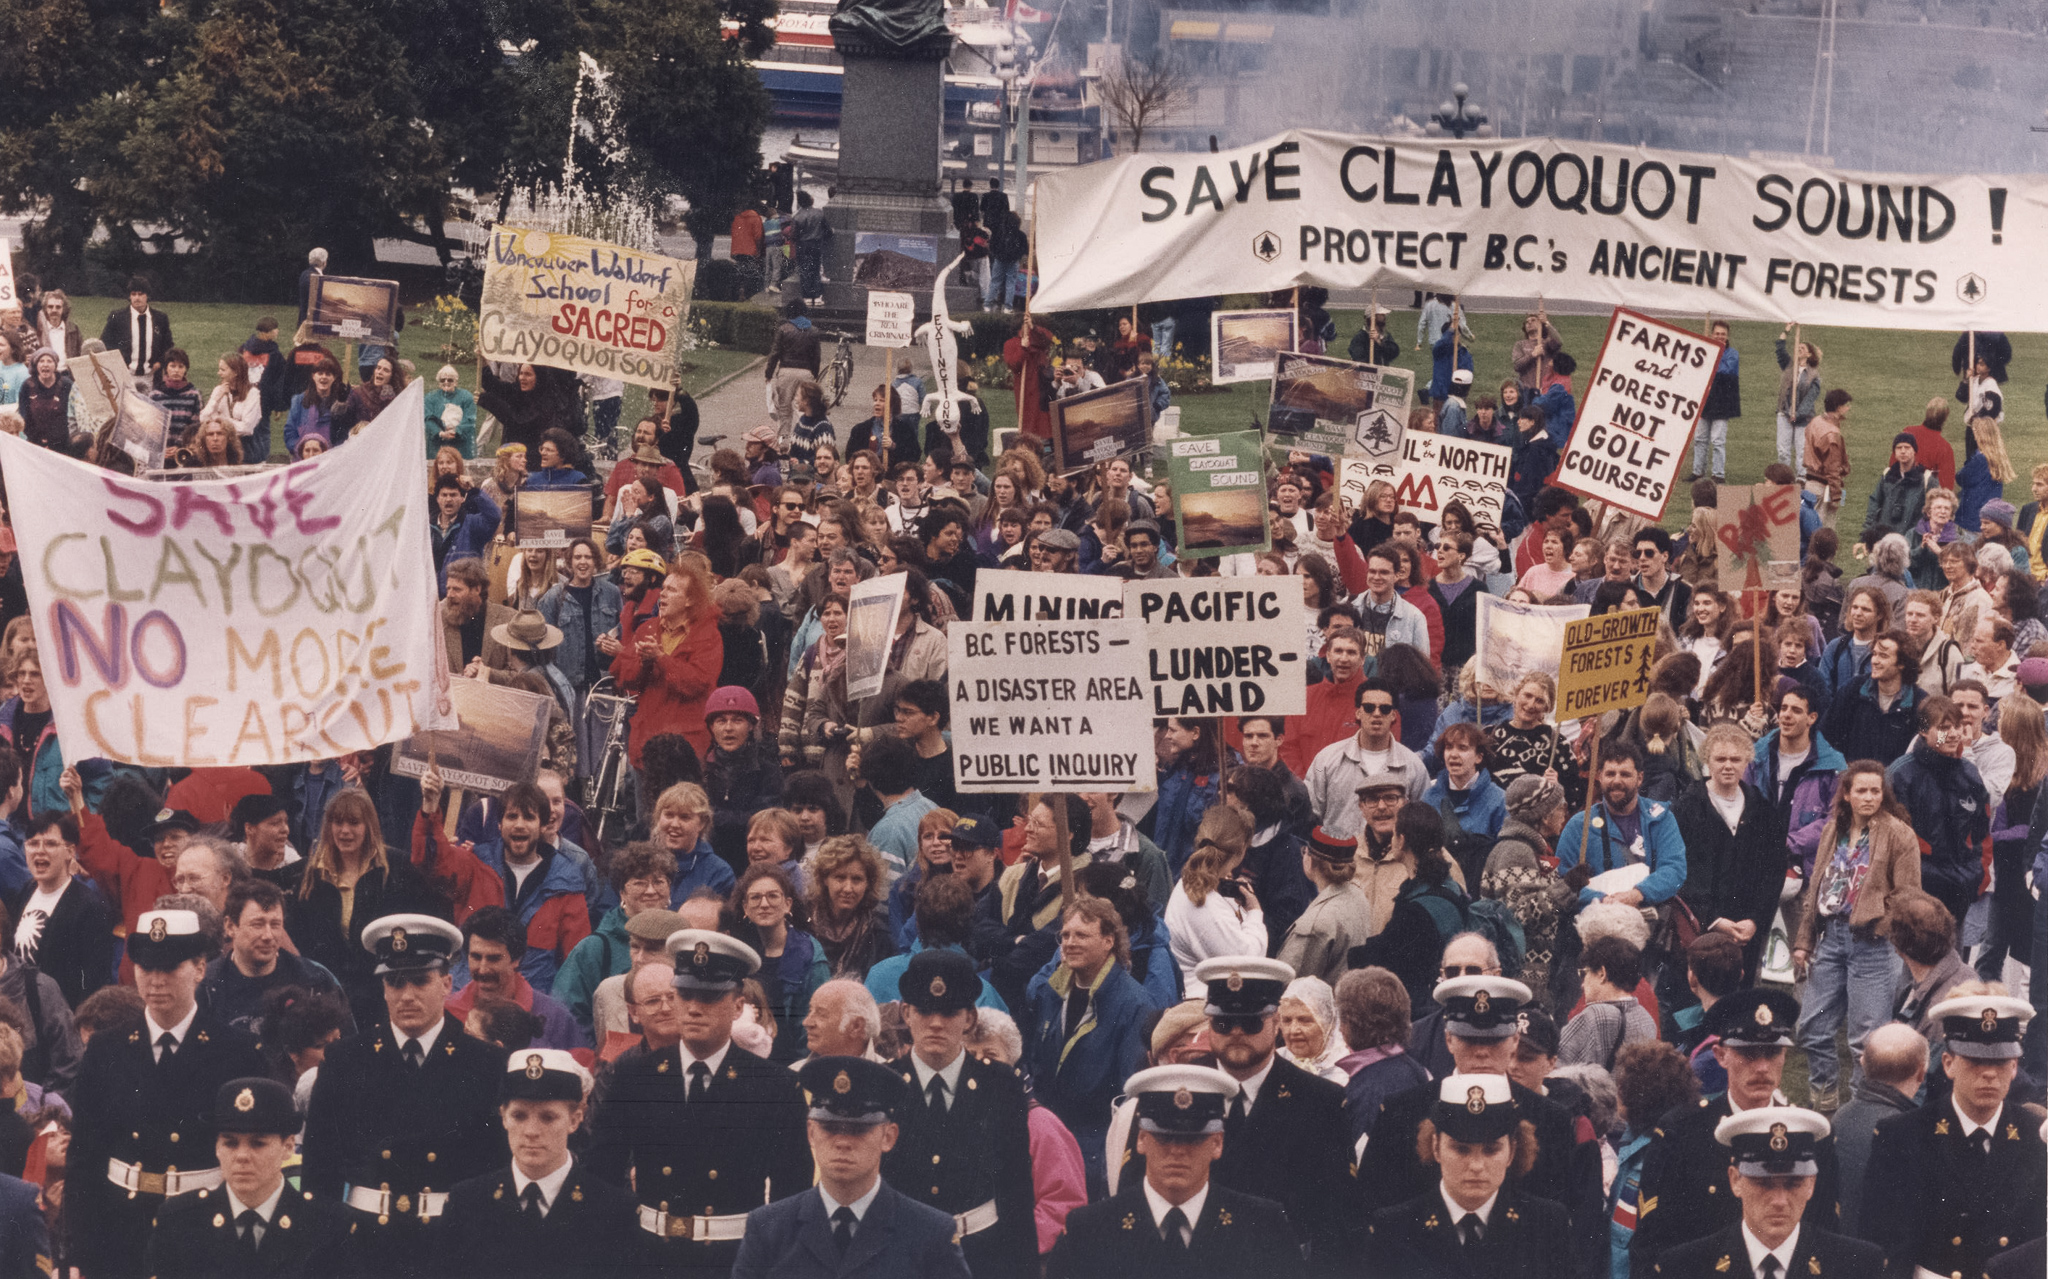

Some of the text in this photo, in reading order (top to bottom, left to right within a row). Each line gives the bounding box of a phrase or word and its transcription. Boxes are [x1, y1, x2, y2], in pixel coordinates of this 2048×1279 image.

[779, 19, 814, 30] ROYAL
[1141, 142, 2007, 245] SAVE CLAYOQUOT SOUND !
[591, 249, 672, 293] Waldorf
[1301, 225, 1467, 270] PROTECT
[1589, 239, 1746, 289] ANCIENT
[1765, 258, 1938, 303] FORESTS
[527, 274, 611, 305] School
[626, 290, 675, 317] for a
[872, 301, 894, 309] WHO
[552, 303, 666, 352] SACRED
[869, 331, 910, 340] CRIMINALS
[1617, 320, 1707, 368] FARMS
[934, 314, 951, 429] EXTINCTIONS
[1635, 359, 1678, 379] and
[1597, 368, 1699, 420] FORESTS
[1612, 403, 1665, 438] NOT
[1179, 442, 1213, 454] SAVE
[1423, 439, 1432, 447] of
[1423, 450, 1436, 459] the
[1588, 425, 1670, 470] GOLF
[1439, 445, 1507, 478] NORTH
[1565, 450, 1665, 502] COURSES
[1212, 474, 1257, 485] SOUND
[102, 464, 342, 538] SAVE
[984, 592, 1122, 621] MINING
[1141, 591, 1281, 624] PACIFIC
[965, 632, 997, 657] B.C.
[1005, 630, 1100, 654] FORESTS
[1567, 612, 1658, 646] OLD-GROWTH
[49, 600, 407, 699] NO MORE
[1149, 645, 1298, 682] LUNDER-
[1570, 644, 1633, 673] FORESTS
[956, 676, 1143, 702] A DISASTER AREA
[1154, 681, 1265, 716] LAND
[1566, 680, 1630, 712] FOREVER
[83, 680, 421, 764] CLEARCUT
[970, 716, 1093, 736] WE WANT A
[399, 761, 424, 772] SAVE
[960, 753, 1138, 777] PUBLIC INQUIRY
